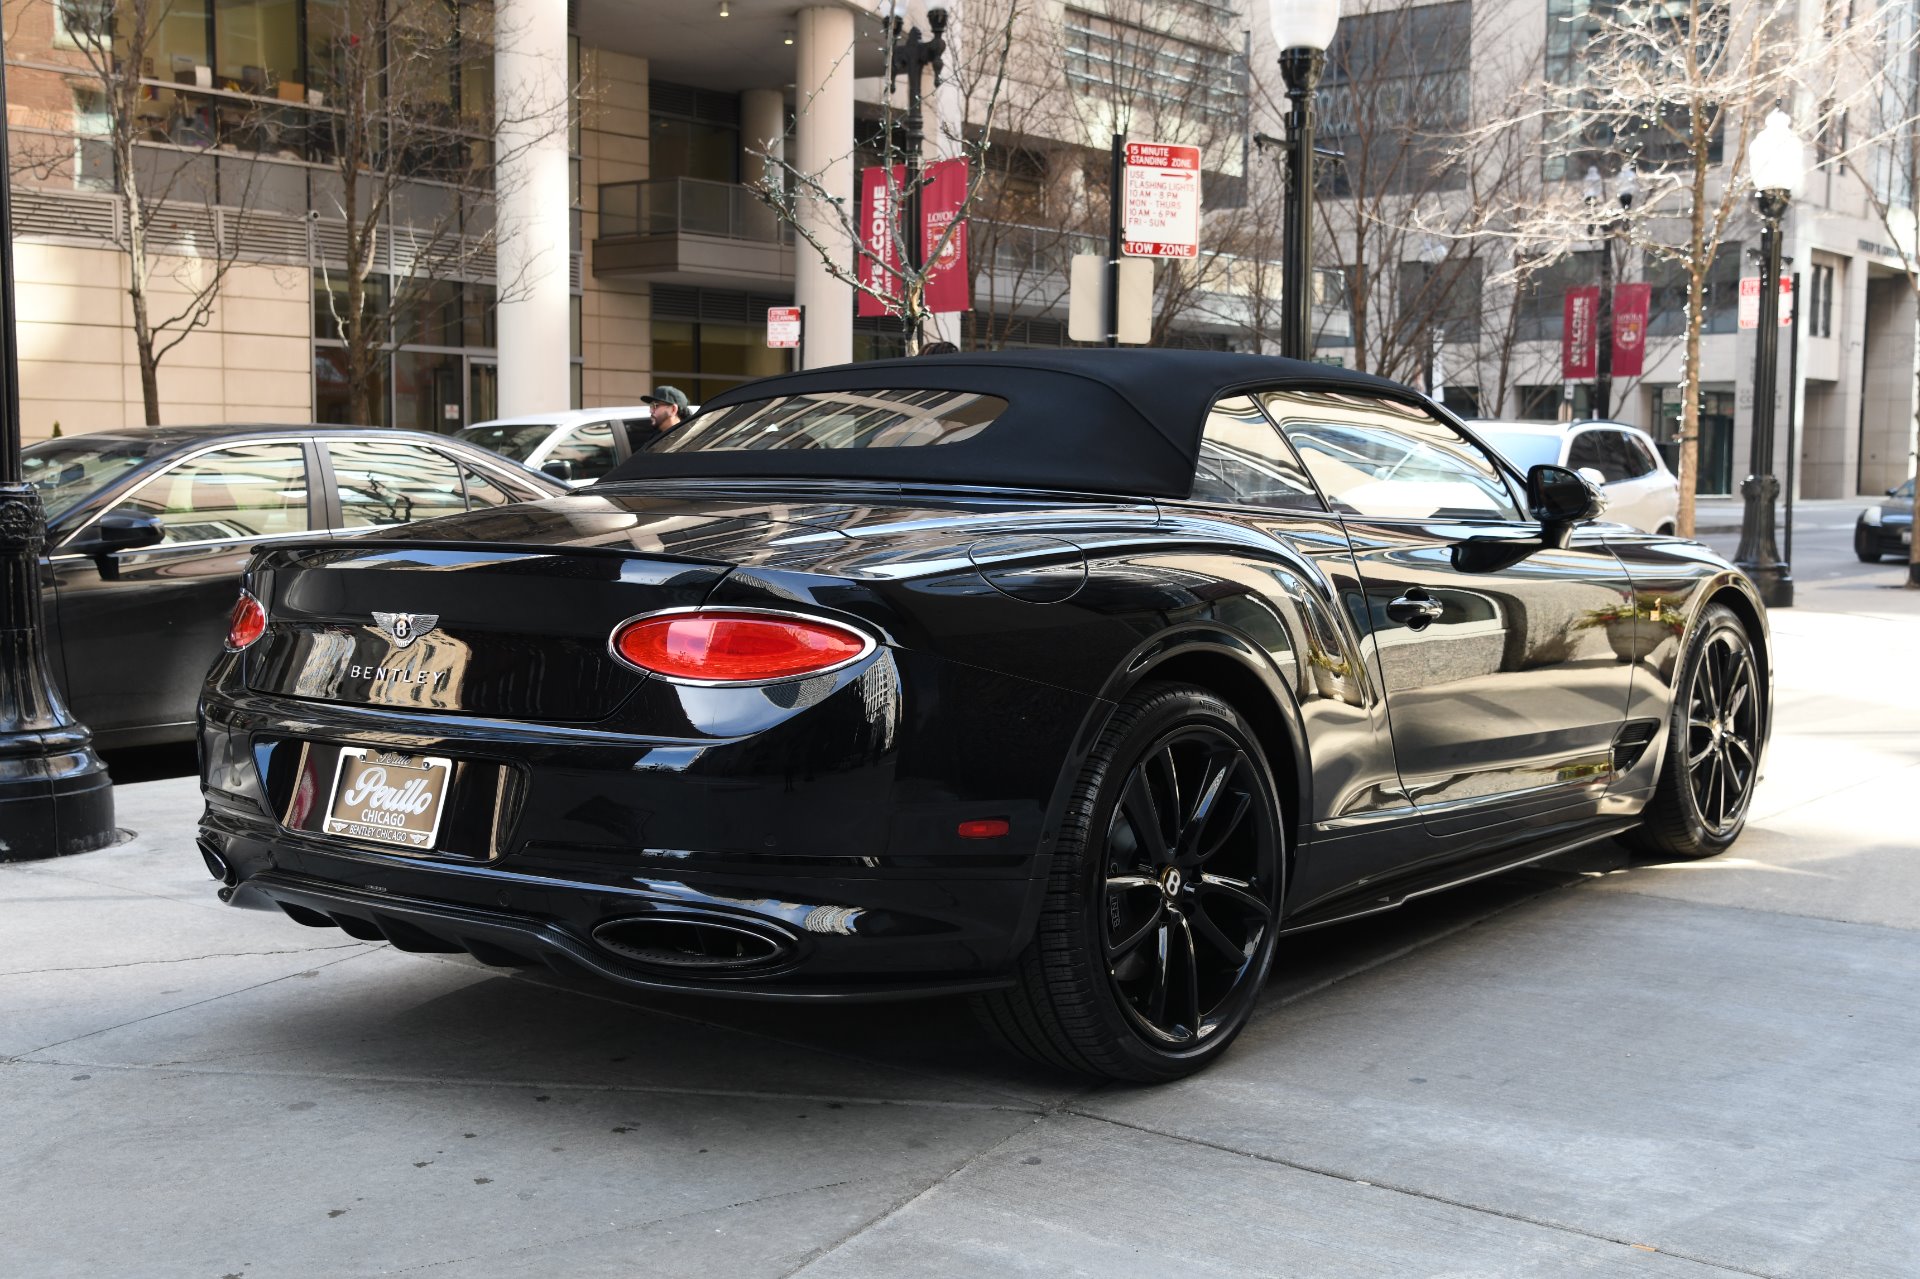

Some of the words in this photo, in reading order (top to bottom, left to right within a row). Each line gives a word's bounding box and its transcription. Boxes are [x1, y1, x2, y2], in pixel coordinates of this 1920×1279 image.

[1130, 146, 1139, 155] 15
[1141, 146, 1169, 157] MINUTE
[1130, 156, 1168, 167] STANDING
[1171, 158, 1192, 168] ZONE
[1130, 171, 1144, 179] USE
[1129, 181, 1167, 190] FLASHING
[1169, 183, 1195, 192] LIGHTS
[1129, 190, 1137, 198] 10
[1156, 200, 1181, 209] THURS
[1129, 208, 1137, 216] 10
[1129, 217, 1142, 225] FRI
[1149, 218, 1166, 227] SUN
[871, 186, 886, 295] WELCOME
[1128, 242, 1153, 254] TOW
[1159, 244, 1191, 256] ZONE
[350, 665, 445, 685] BENTLEY
[344, 766, 433, 816] Perillo
[361, 808, 406, 827] CHICAGO
[349, 824, 376, 838] BENTLEY
[376, 828, 407, 842] CHICAGO
